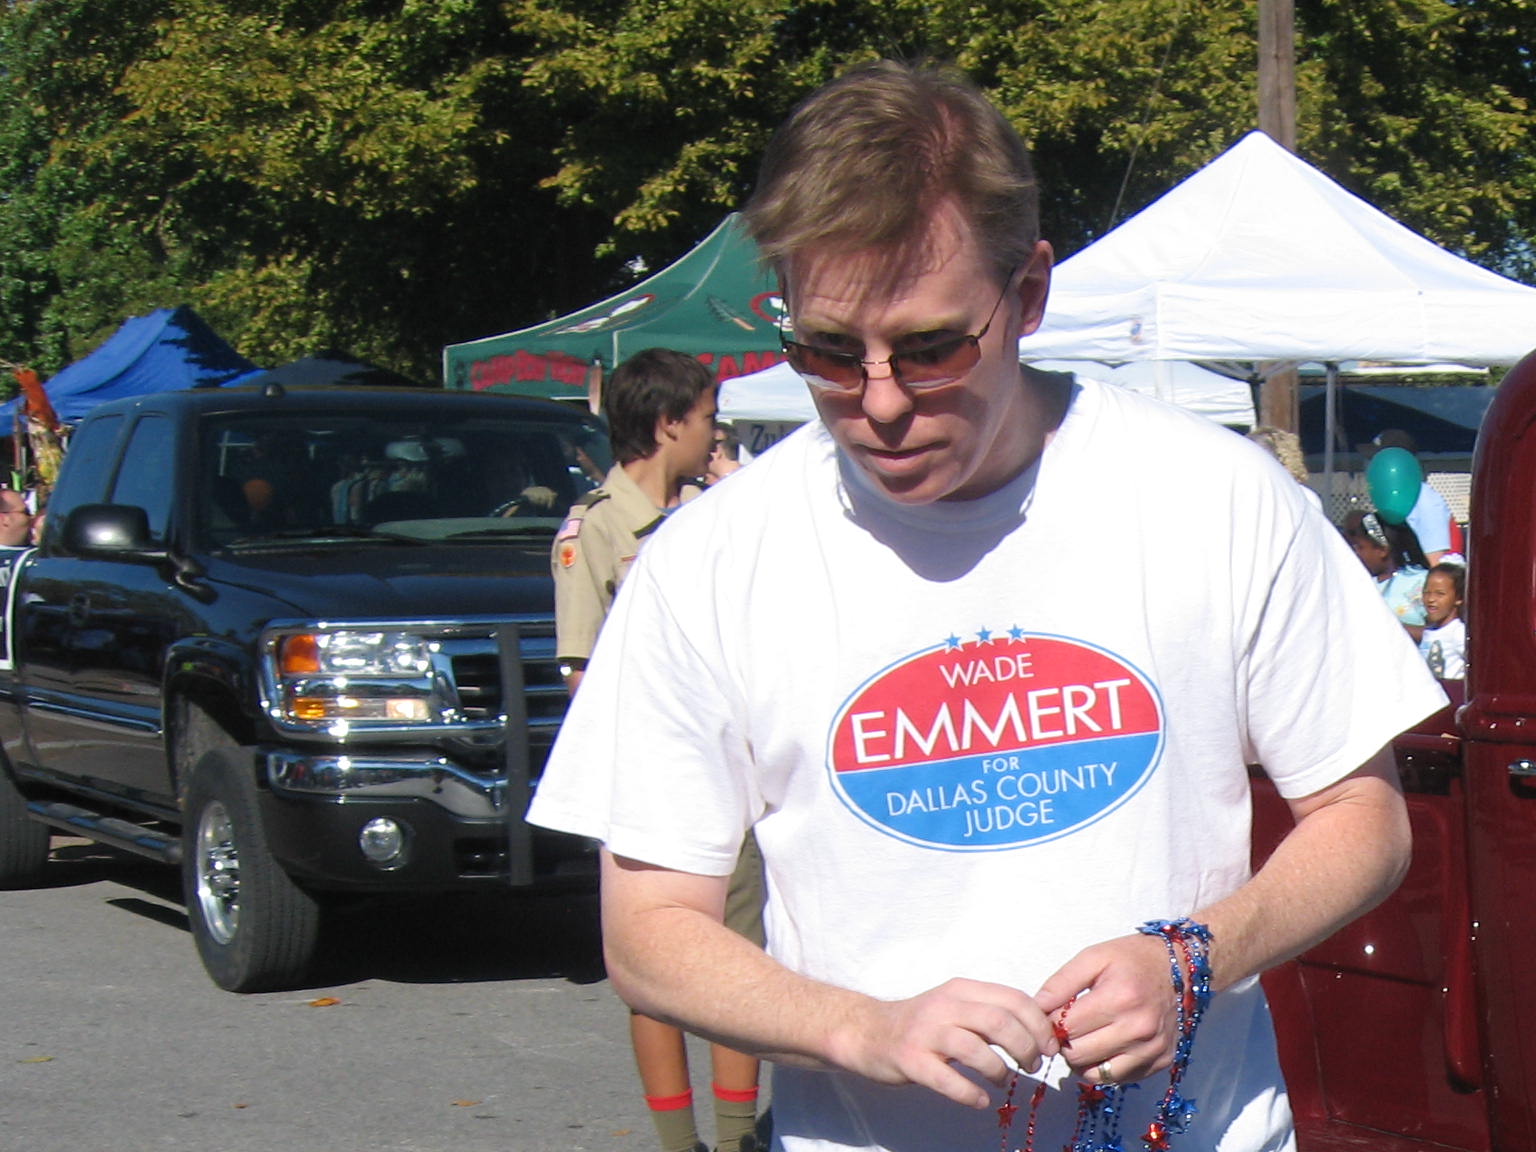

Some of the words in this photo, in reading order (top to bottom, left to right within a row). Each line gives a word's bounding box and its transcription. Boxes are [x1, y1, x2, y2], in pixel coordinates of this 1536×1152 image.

[939, 653, 1034, 688] WADE
[851, 679, 1130, 763] EMMERT
[982, 757, 1020, 774] FOR
[886, 780, 988, 816] DALLAS
[997, 762, 1118, 800] COUNTY
[963, 799, 1054, 837] JUDGE
